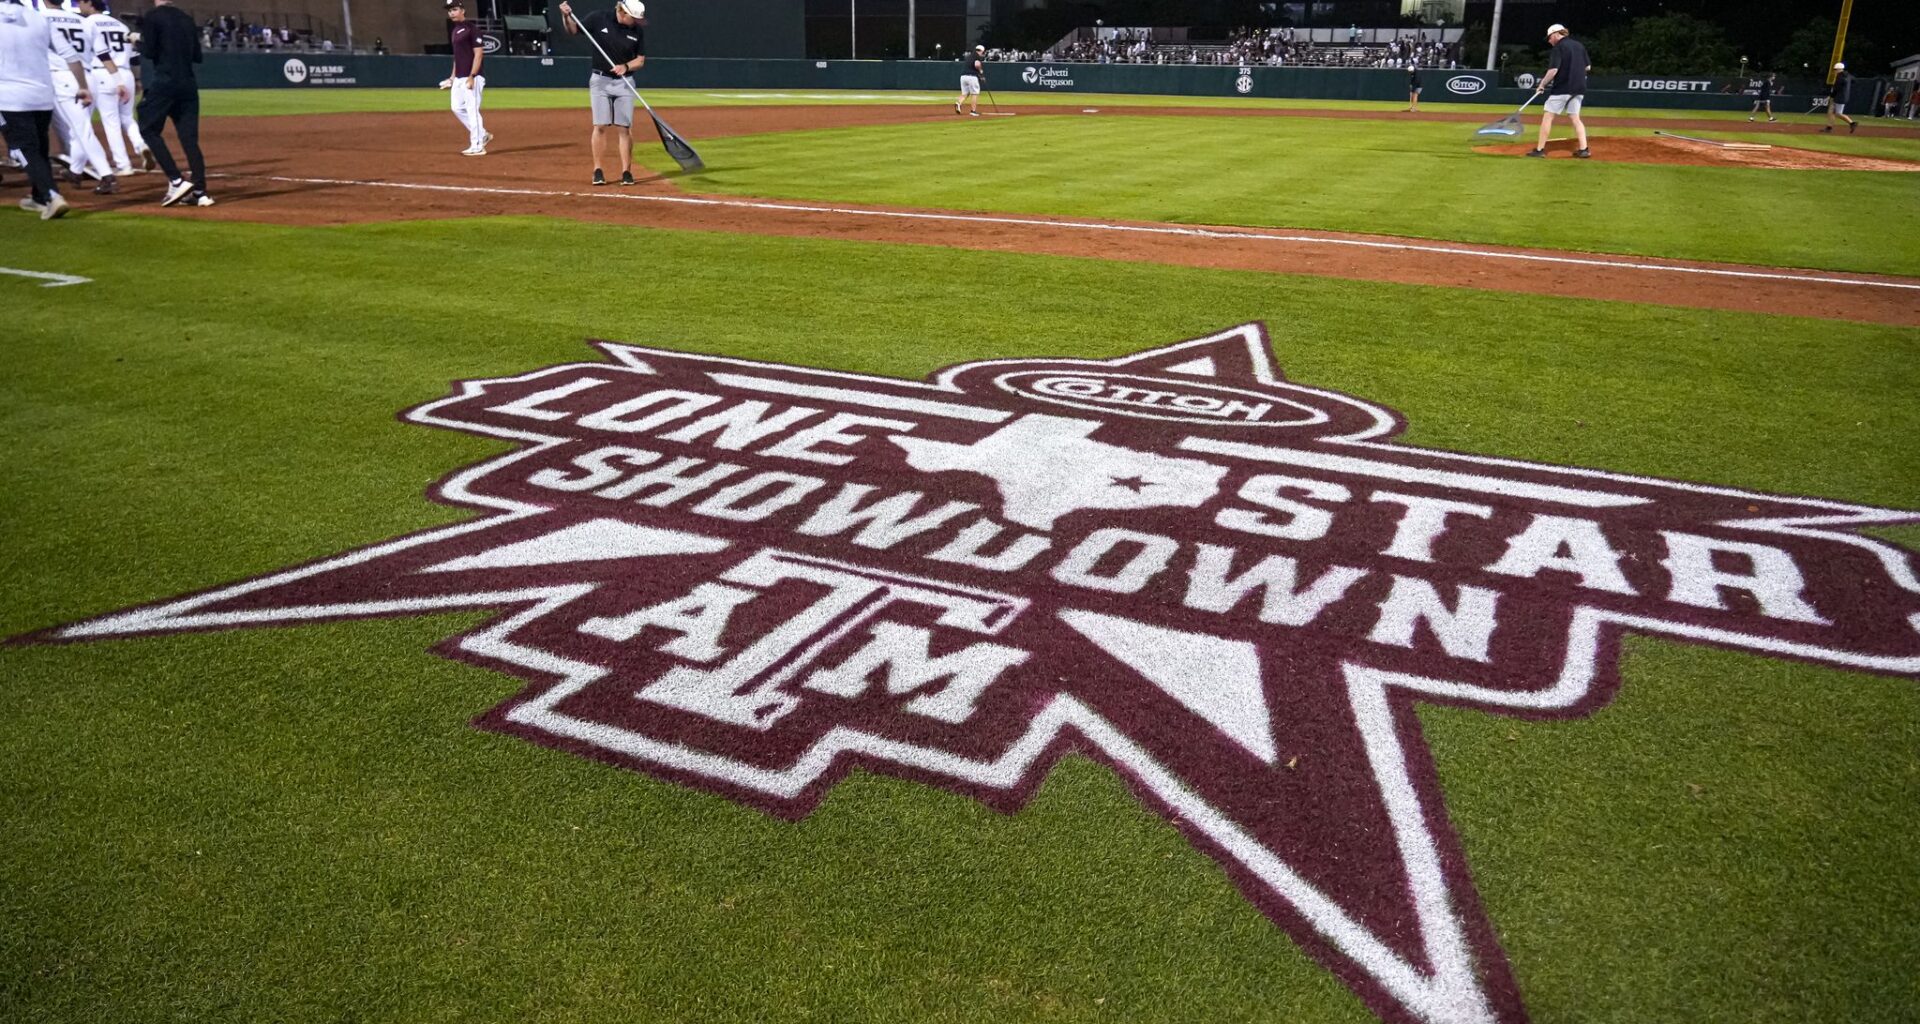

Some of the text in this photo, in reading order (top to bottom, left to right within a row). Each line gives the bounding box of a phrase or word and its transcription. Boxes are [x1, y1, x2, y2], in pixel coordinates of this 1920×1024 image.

[101, 31, 125, 52] 19
[309, 65, 344, 74] FARMS
[1038, 66, 1069, 77] Calvetti
[1239, 67, 1251, 75] 375
[1039, 76, 1074, 89] Ferguson
[1627, 79, 1712, 91] DOGGETT
[483, 376, 1835, 627] LONE STAR
[526, 445, 1506, 664] SHOWDOWN
